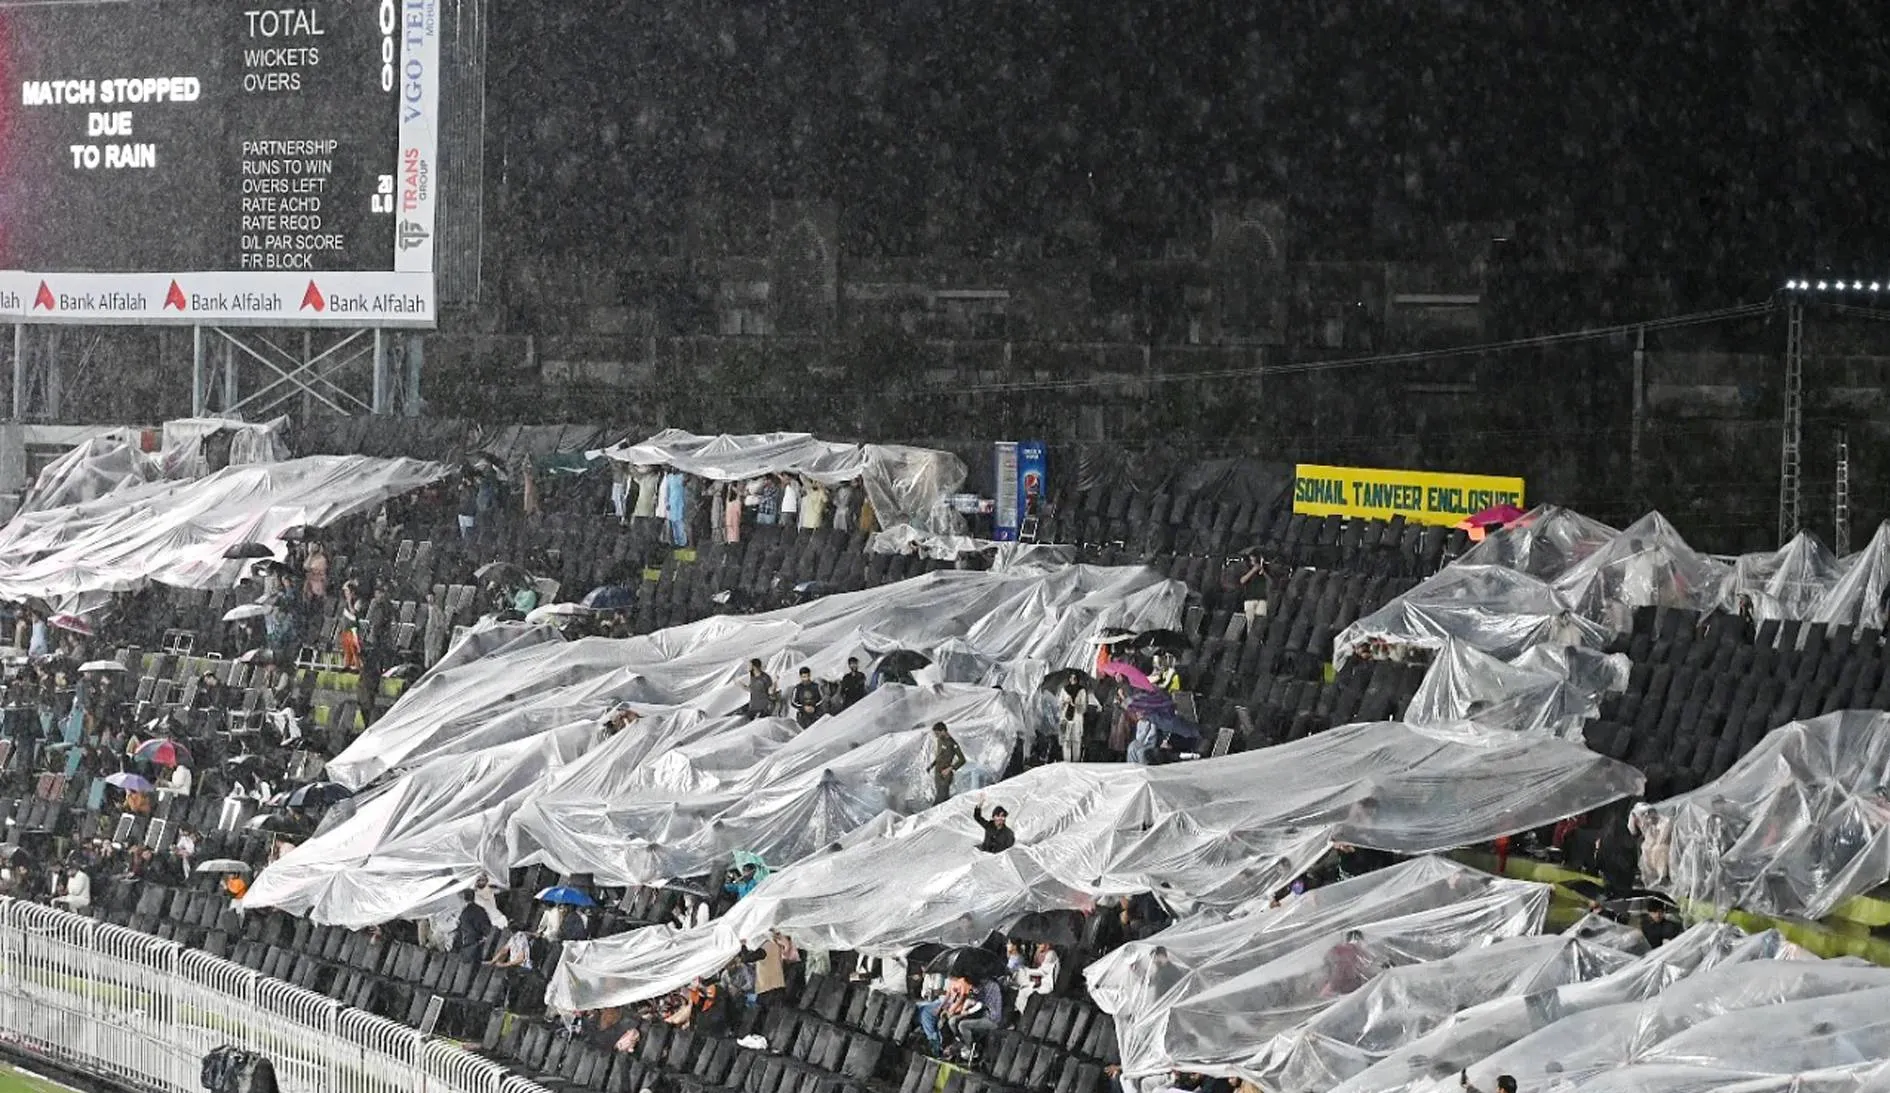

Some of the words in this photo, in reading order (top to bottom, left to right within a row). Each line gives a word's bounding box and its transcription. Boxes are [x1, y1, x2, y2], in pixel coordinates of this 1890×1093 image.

[244, 8, 325, 38] TOTAL
[379, 0, 395, 35] 0
[244, 47, 319, 67] WICKETS
[381, 36, 394, 63] 0
[244, 72, 301, 92] OVERS
[381, 63, 394, 92] 0
[22, 79, 96, 105] MATCH
[100, 77, 201, 103] STOPPED
[404, 59, 424, 124] VGO
[87, 110, 133, 136] DUE
[69, 144, 101, 169] TO
[104, 143, 156, 168] RAIN
[242, 139, 338, 156] PARTNERSHIP
[242, 159, 281, 175] RUNS
[283, 159, 302, 175] TO
[304, 159, 333, 174] WIN
[242, 178, 289, 194] OVERS
[292, 177, 326, 193] LEFT
[403, 147, 419, 213] TRANS
[419, 159, 429, 201] GROUP
[242, 197, 276, 212] RATE
[279, 196, 321, 212] ACH'D
[242, 215, 276, 231] RATE
[280, 214, 321, 231] REQ'D
[241, 234, 263, 250] D/L
[265, 234, 293, 249] PAR
[295, 234, 344, 250] SCORE
[241, 253, 263, 269] F/R
[266, 253, 313, 269] BLOCK
[60, 293, 95, 310] Bank
[98, 292, 147, 310] Alfalah
[192, 293, 228, 311] Bank
[231, 293, 282, 311] Alfalah
[330, 295, 369, 312] Bank
[372, 294, 425, 313] Alfalah
[1296, 478, 1347, 505] SOHAIL
[1352, 481, 1423, 511] TANVEER
